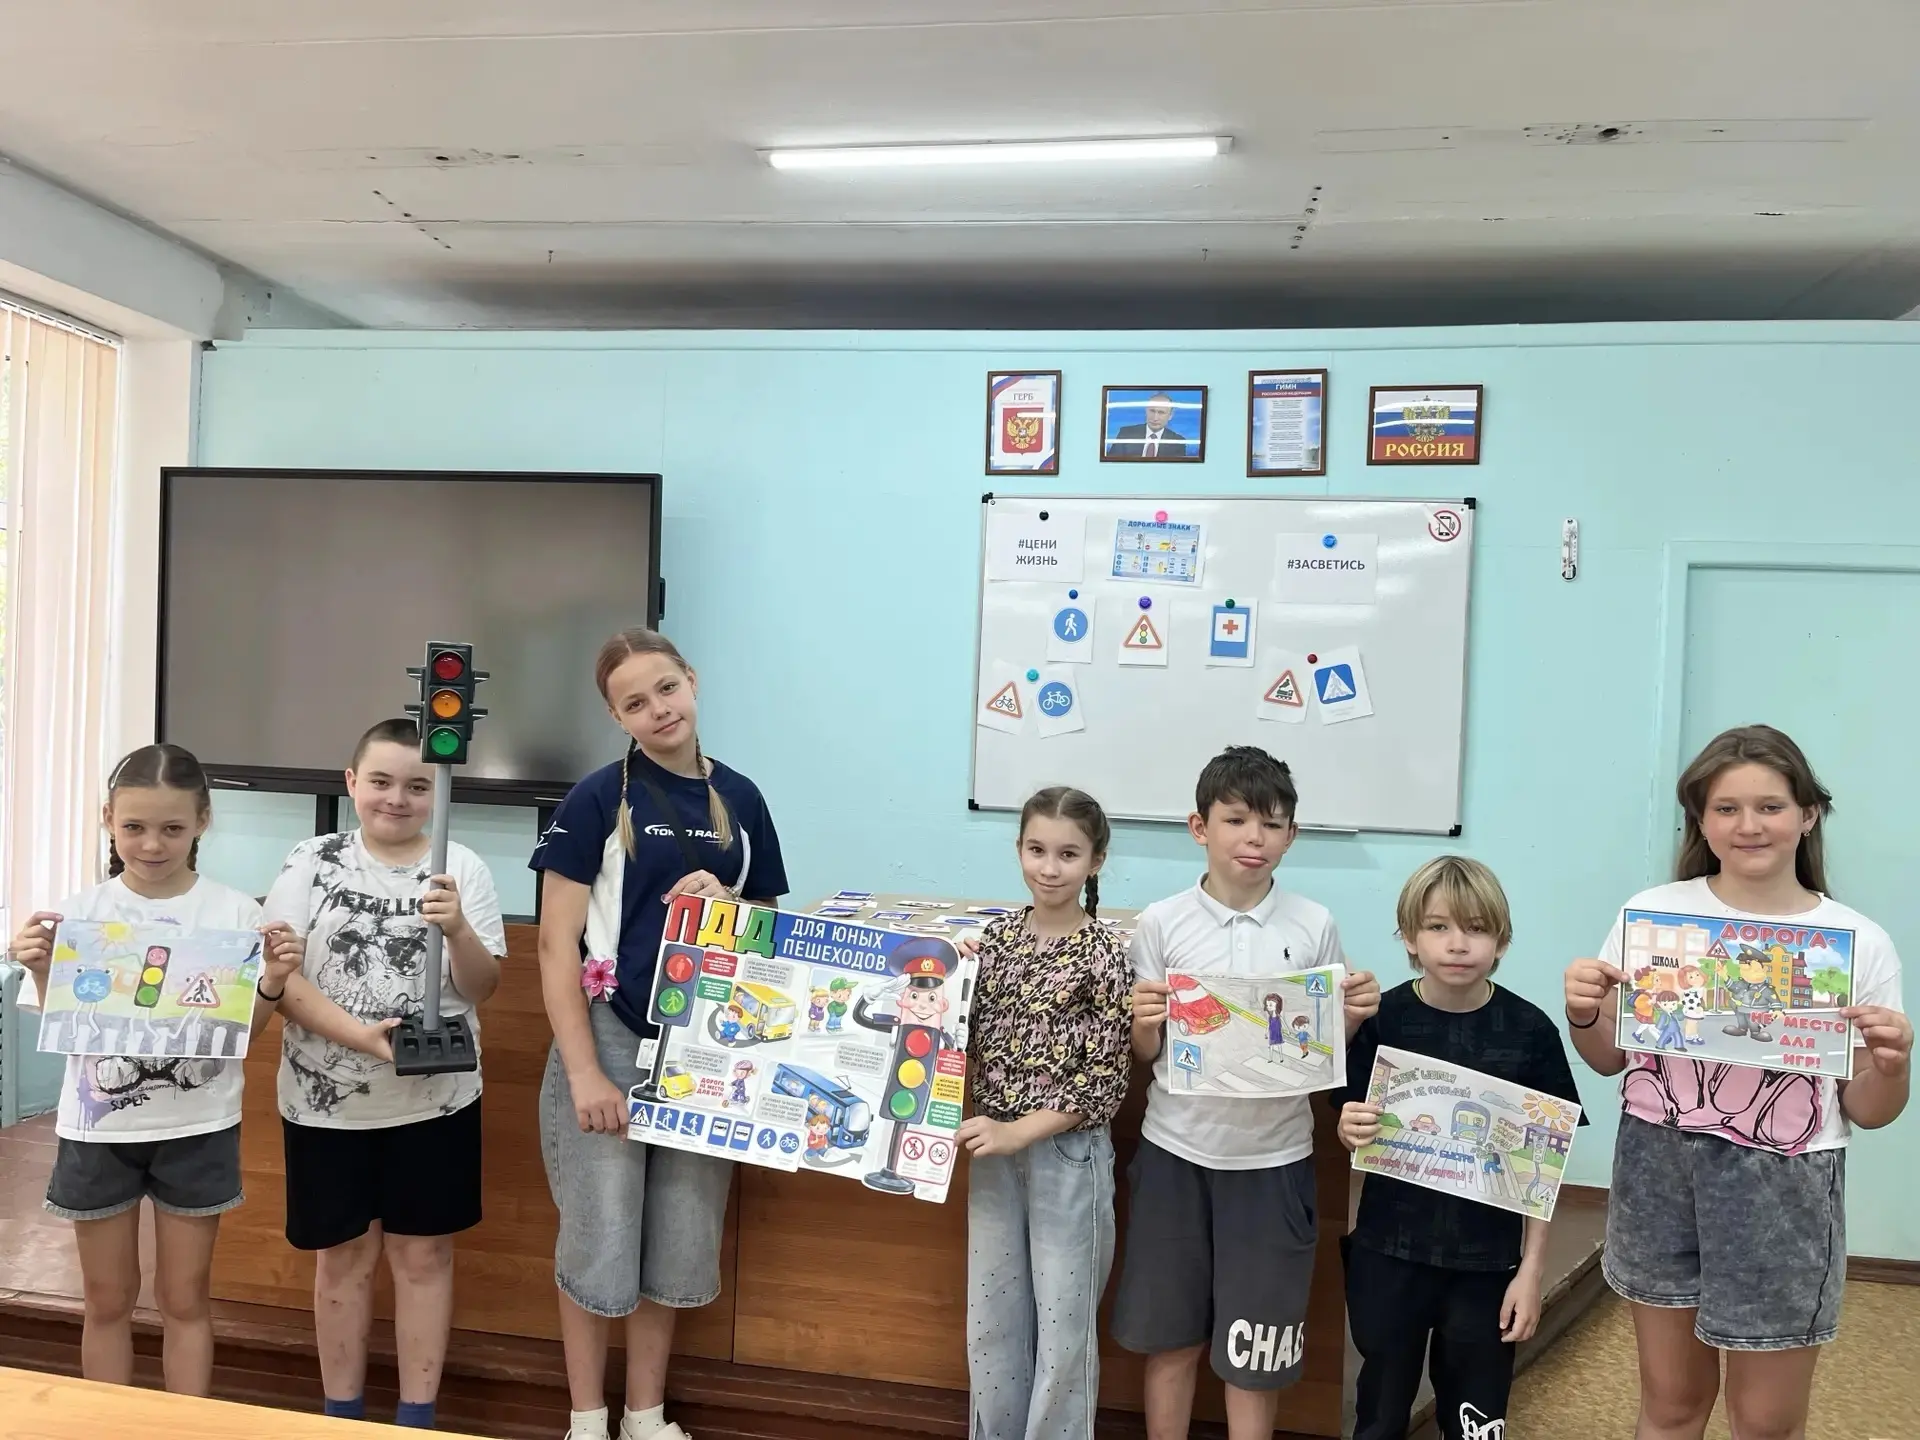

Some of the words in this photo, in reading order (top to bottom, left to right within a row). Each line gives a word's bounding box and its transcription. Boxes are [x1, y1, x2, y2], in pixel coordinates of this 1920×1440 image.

[1013, 393, 1034, 401] ГЕРБ
[1385, 443, 1465, 457] РОССИЯ
[1128, 521, 1167, 529] ДОРОЖНЫЕ
[1168, 523, 1191, 531] ЗНАКИ
[1018, 539, 1057, 550] #ЦЕНИ
[1016, 555, 1058, 565] ЖИЗНЬ
[1287, 559, 1365, 570] #ЗАСВЕТИСЬ
[665, 893, 777, 959] ПДД
[791, 918, 825, 939] ДЛЯ
[832, 925, 885, 949] ЮНЫХ
[783, 938, 886, 972] ПЕШЕХОДОВ
[1651, 955, 1680, 969] ШКОЛА
[1751, 1012, 1773, 1025] НЕ
[1783, 1015, 1847, 1034] МЕСТО
[1779, 1035, 1816, 1049] ДЛЯ
[1782, 1054, 1821, 1068] ИГР!
[700, 1077, 725, 1086] ДОРОГА
